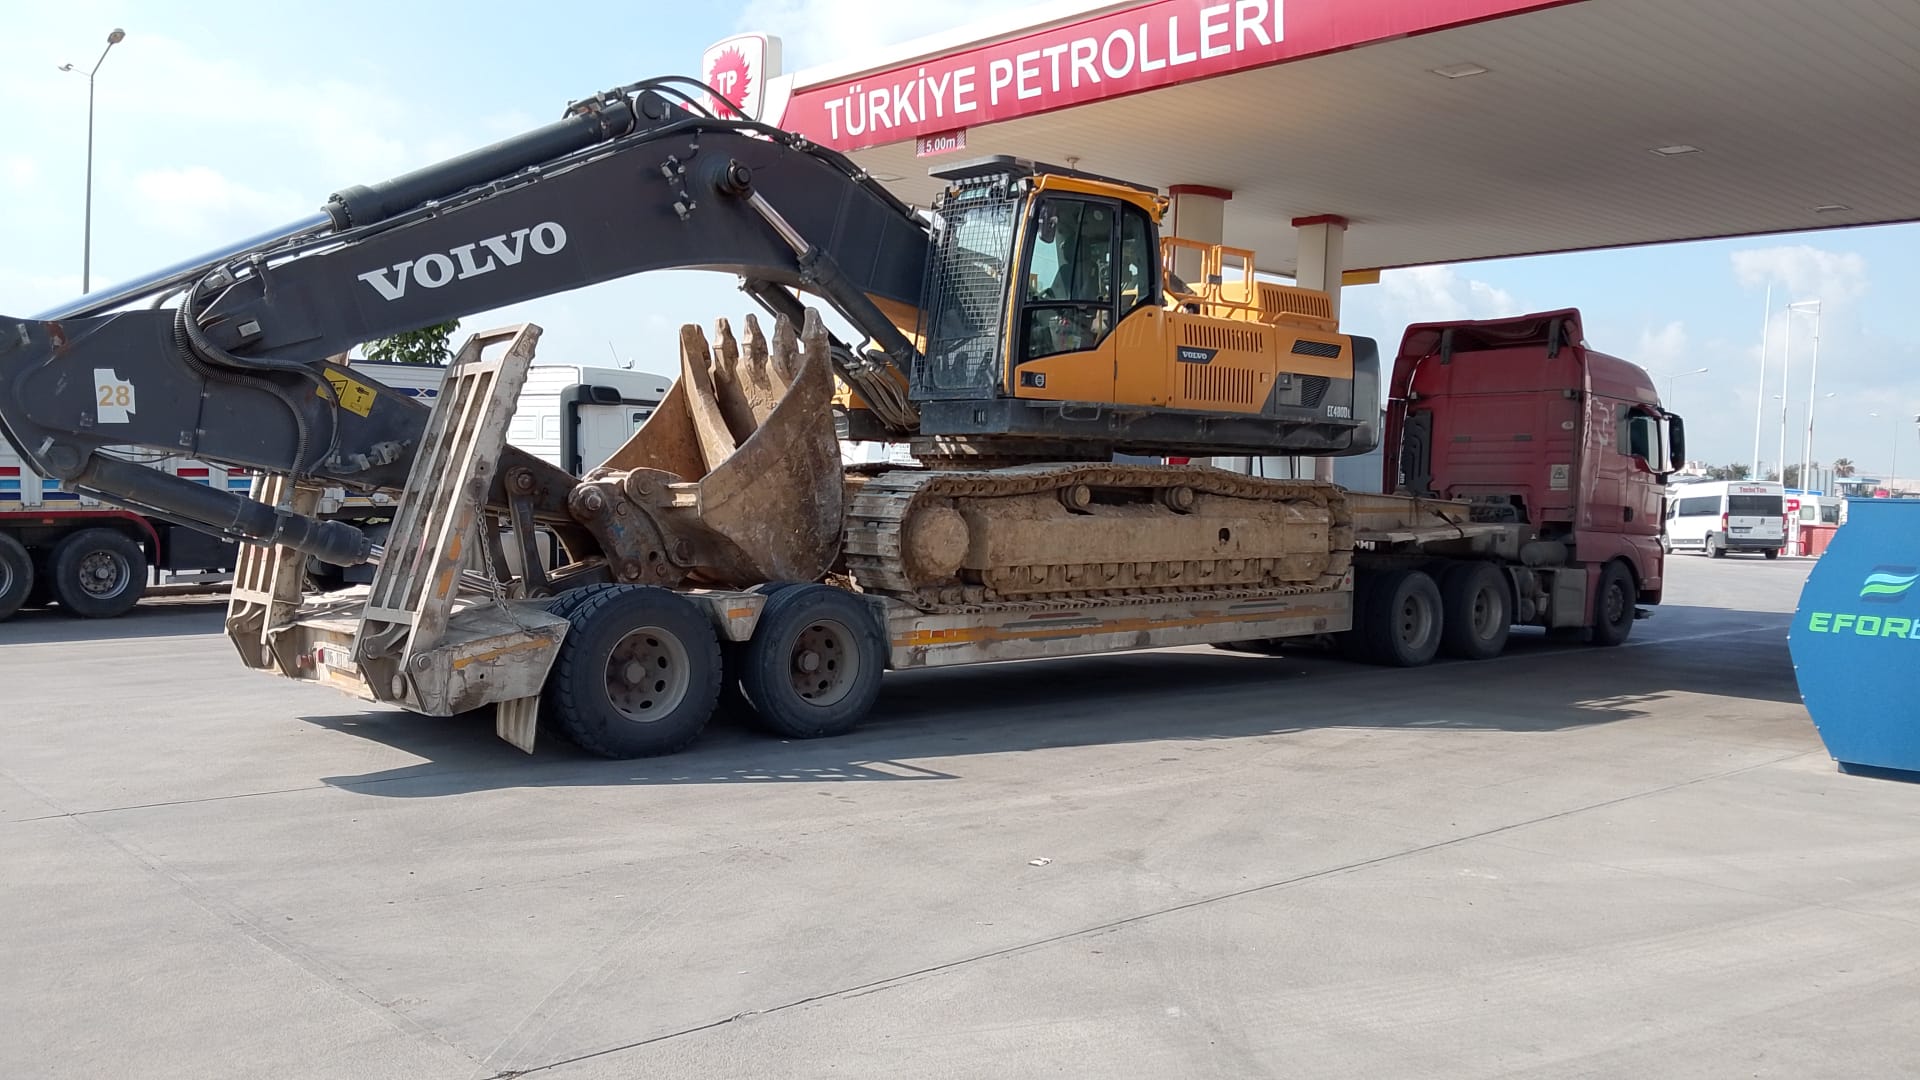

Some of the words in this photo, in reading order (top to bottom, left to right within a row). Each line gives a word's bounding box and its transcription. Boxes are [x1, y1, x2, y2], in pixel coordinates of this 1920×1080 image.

[716, 70, 738, 96] TP
[824, 67, 977, 140] TÜRKİYE
[926, 136, 956, 152] 5.00m
[357, 221, 567, 301] VOLVO
[1182, 350, 1208, 360] VOLVO
[98, 384, 130, 407] 28
